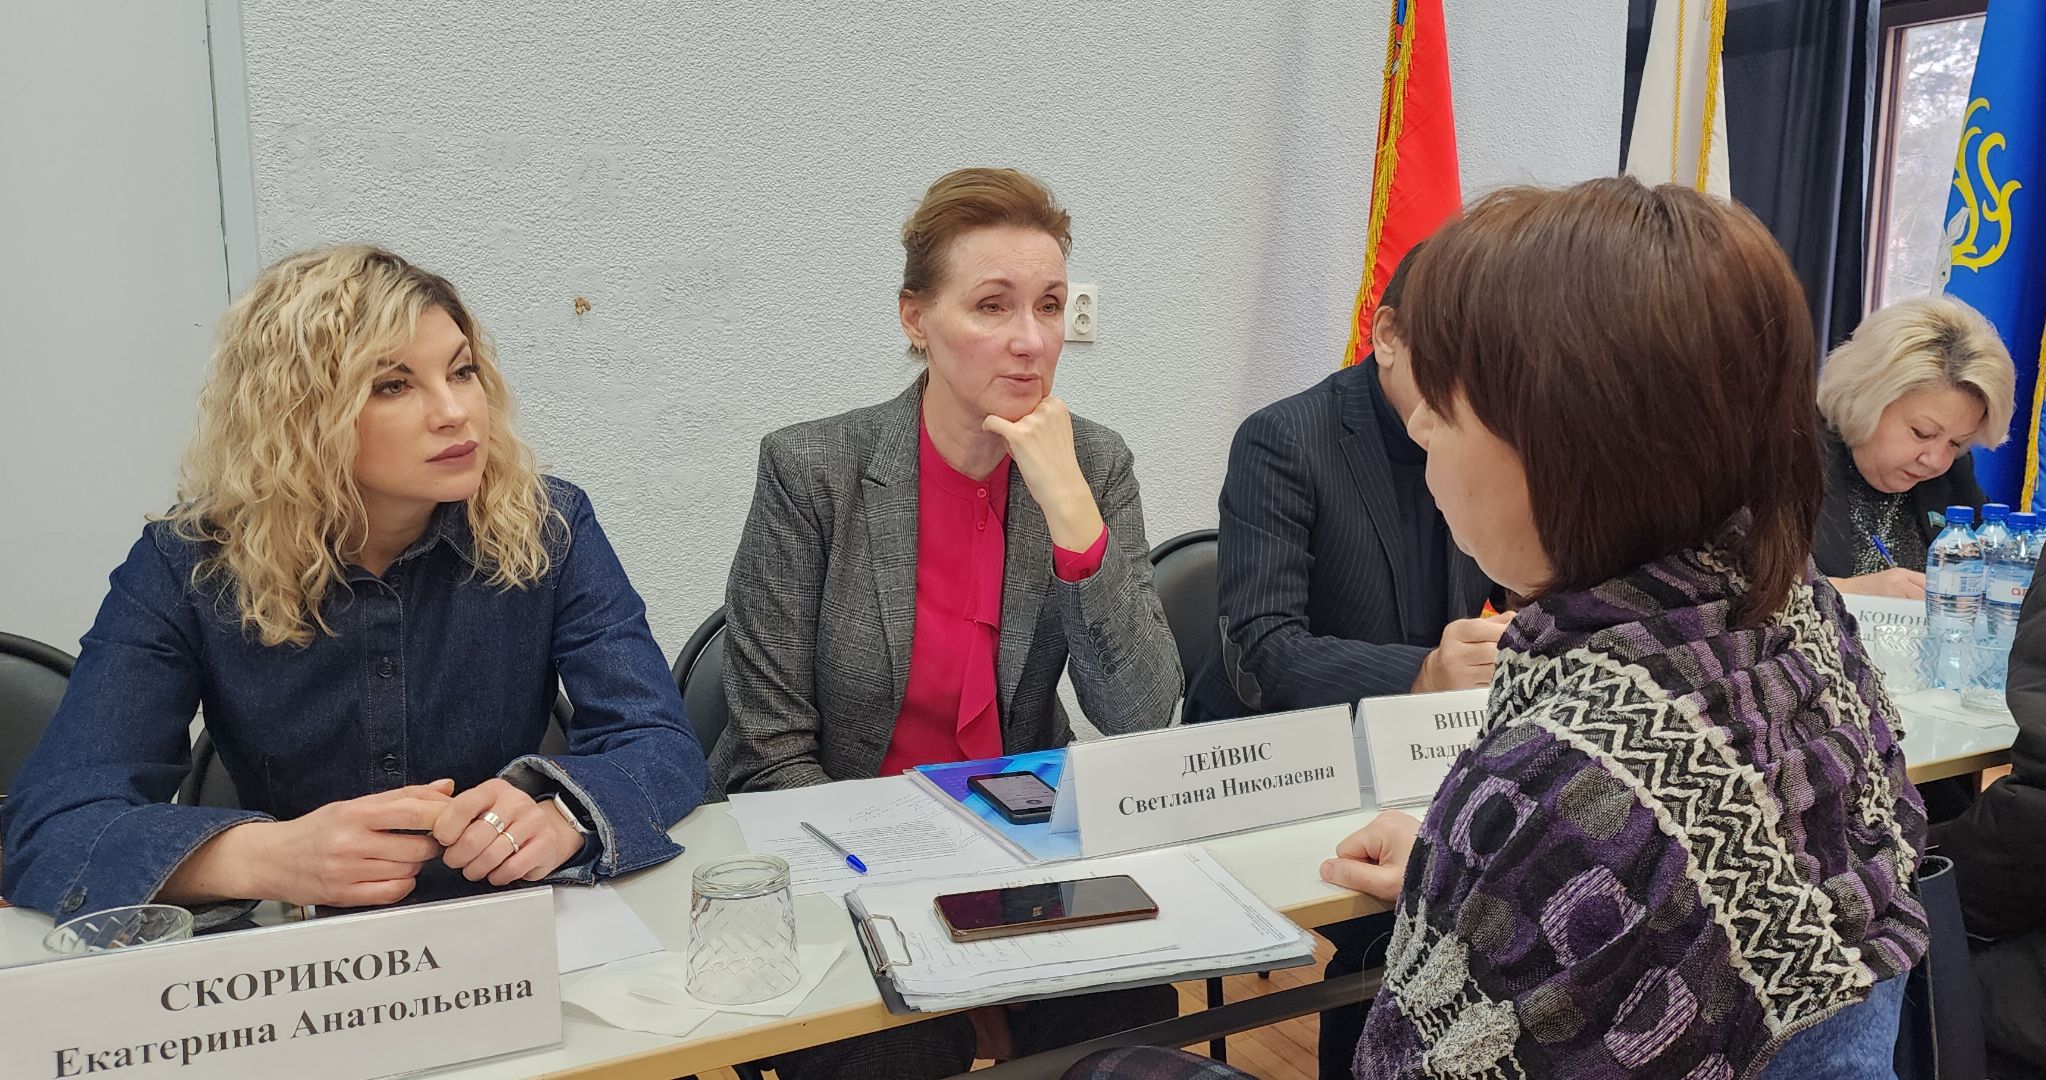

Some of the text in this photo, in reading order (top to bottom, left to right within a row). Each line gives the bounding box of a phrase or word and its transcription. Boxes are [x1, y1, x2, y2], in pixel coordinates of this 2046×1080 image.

[1181, 742, 1273, 779] ДЕЙВИС
[1409, 743, 1471, 761] Влади
[1118, 765, 1335, 816] Светлана Николаевна
[160, 945, 442, 1012] СКОРИКОВА
[52, 978, 534, 1079] Екатерина Анатольевна
